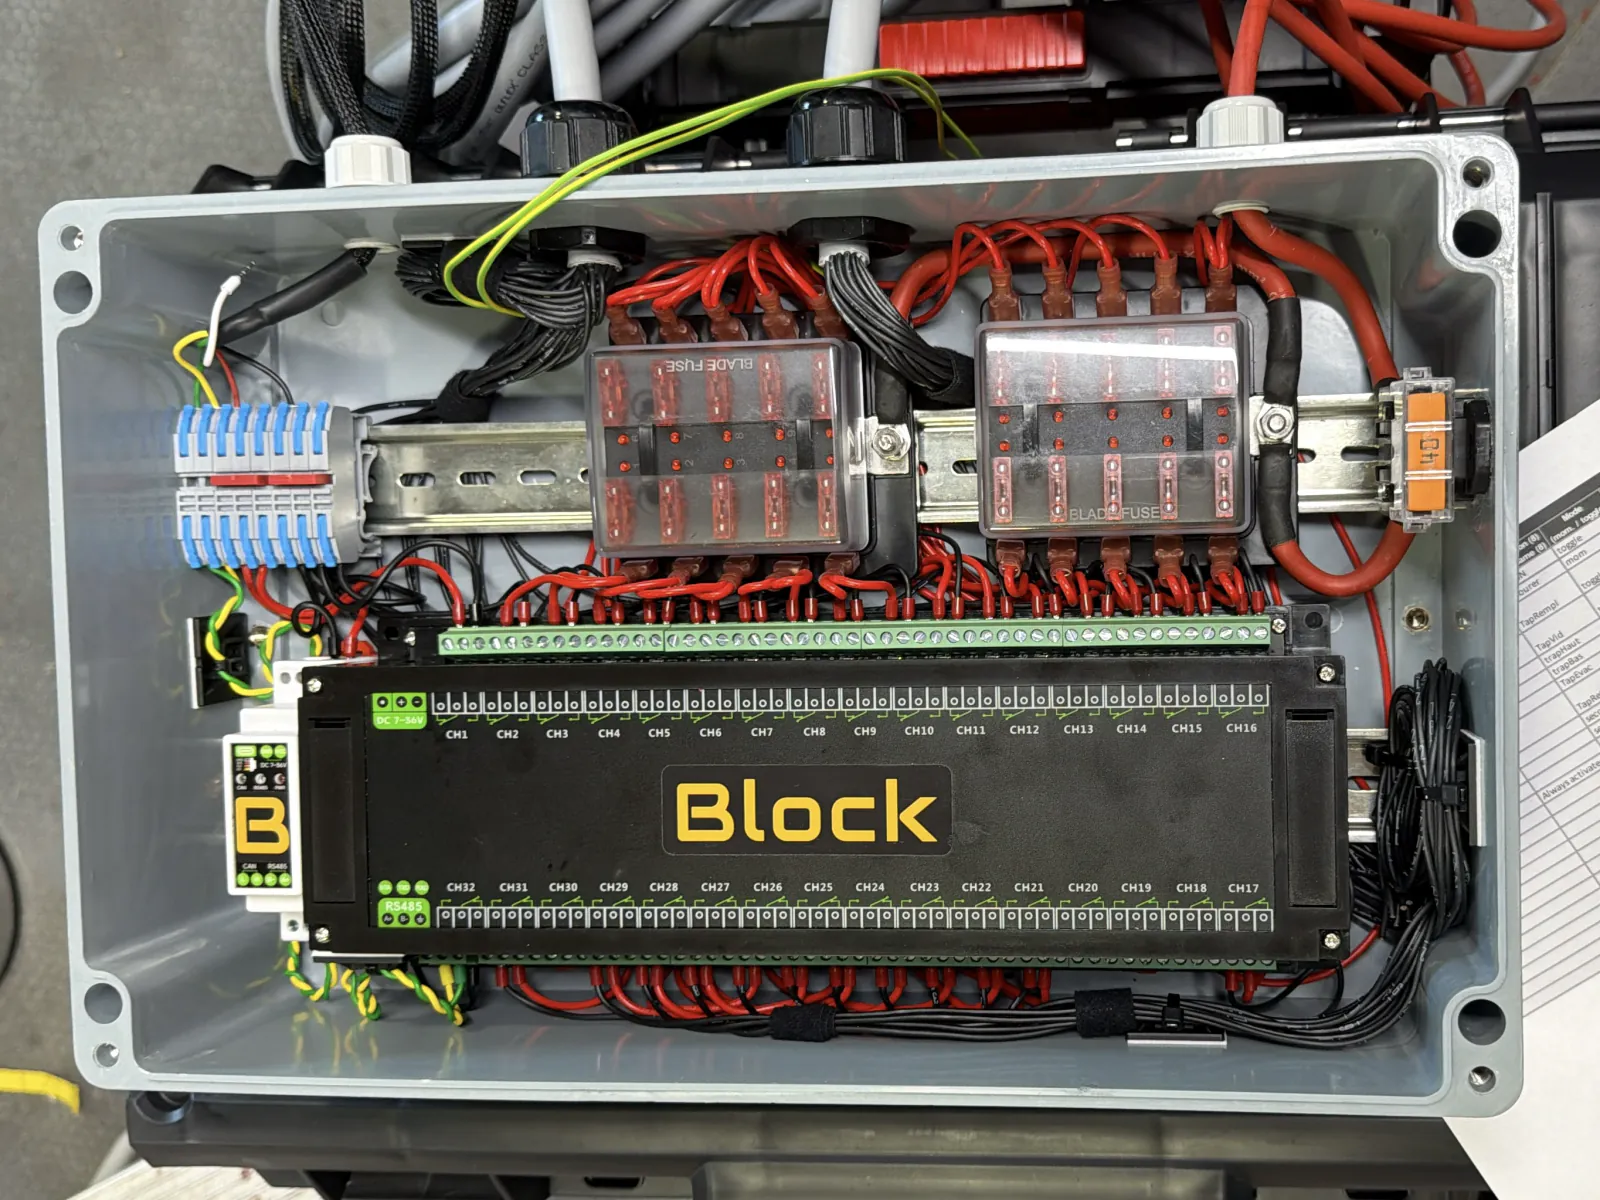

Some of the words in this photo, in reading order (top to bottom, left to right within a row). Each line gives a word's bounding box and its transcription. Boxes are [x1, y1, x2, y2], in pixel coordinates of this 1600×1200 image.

[665, 358, 704, 373] FUSE
[706, 358, 753, 372] BLADE
[1121, 506, 1161, 520] FUSE
[1561, 506, 1585, 522] Mode
[1556, 535, 1584, 555] toggle
[1565, 549, 1588, 566] mom
[1519, 599, 1560, 628] TapRempl
[1535, 630, 1565, 652] TapVid
[1543, 638, 1582, 664] trapHaut
[1551, 653, 1585, 676] trapBas
[1560, 664, 1594, 687] TapEvac
[376, 716, 392, 725] DC
[648, 728, 671, 738] CH5
[699, 727, 722, 738] CH6
[750, 727, 774, 737] CH7
[803, 726, 826, 737] CH8
[853, 726, 877, 737] CH9
[904, 725, 935, 736] CH10
[955, 725, 986, 736] CH11
[1009, 724, 1040, 735] CH12
[1063, 724, 1094, 735] CH13
[1116, 723, 1147, 734] CH14
[1171, 723, 1203, 734] CH15
[1225, 722, 1258, 733] CH16
[445, 729, 469, 740] CH1
[496, 729, 519, 739] CH2
[546, 728, 569, 739] CH3
[597, 728, 621, 739] CH4
[1541, 779, 1571, 801] Always
[676, 778, 938, 843] Block
[235, 796, 290, 855] B
[446, 882, 476, 892] CH32
[499, 882, 528, 893] CH31
[548, 882, 578, 892] CH30
[599, 882, 629, 893] CH29
[649, 882, 679, 892] CH28
[700, 882, 730, 892] CH27
[753, 882, 783, 892] CH26
[803, 882, 833, 892] CH25
[855, 882, 885, 892] CH24
[909, 882, 940, 893] CH23
[961, 882, 992, 893] CH22
[1013, 882, 1044, 893] CH21
[1067, 882, 1099, 893] CH20
[1120, 882, 1152, 893] CH19
[1176, 883, 1208, 893] CH18
[1227, 883, 1260, 894] CH17
[385, 901, 423, 912] RS485
